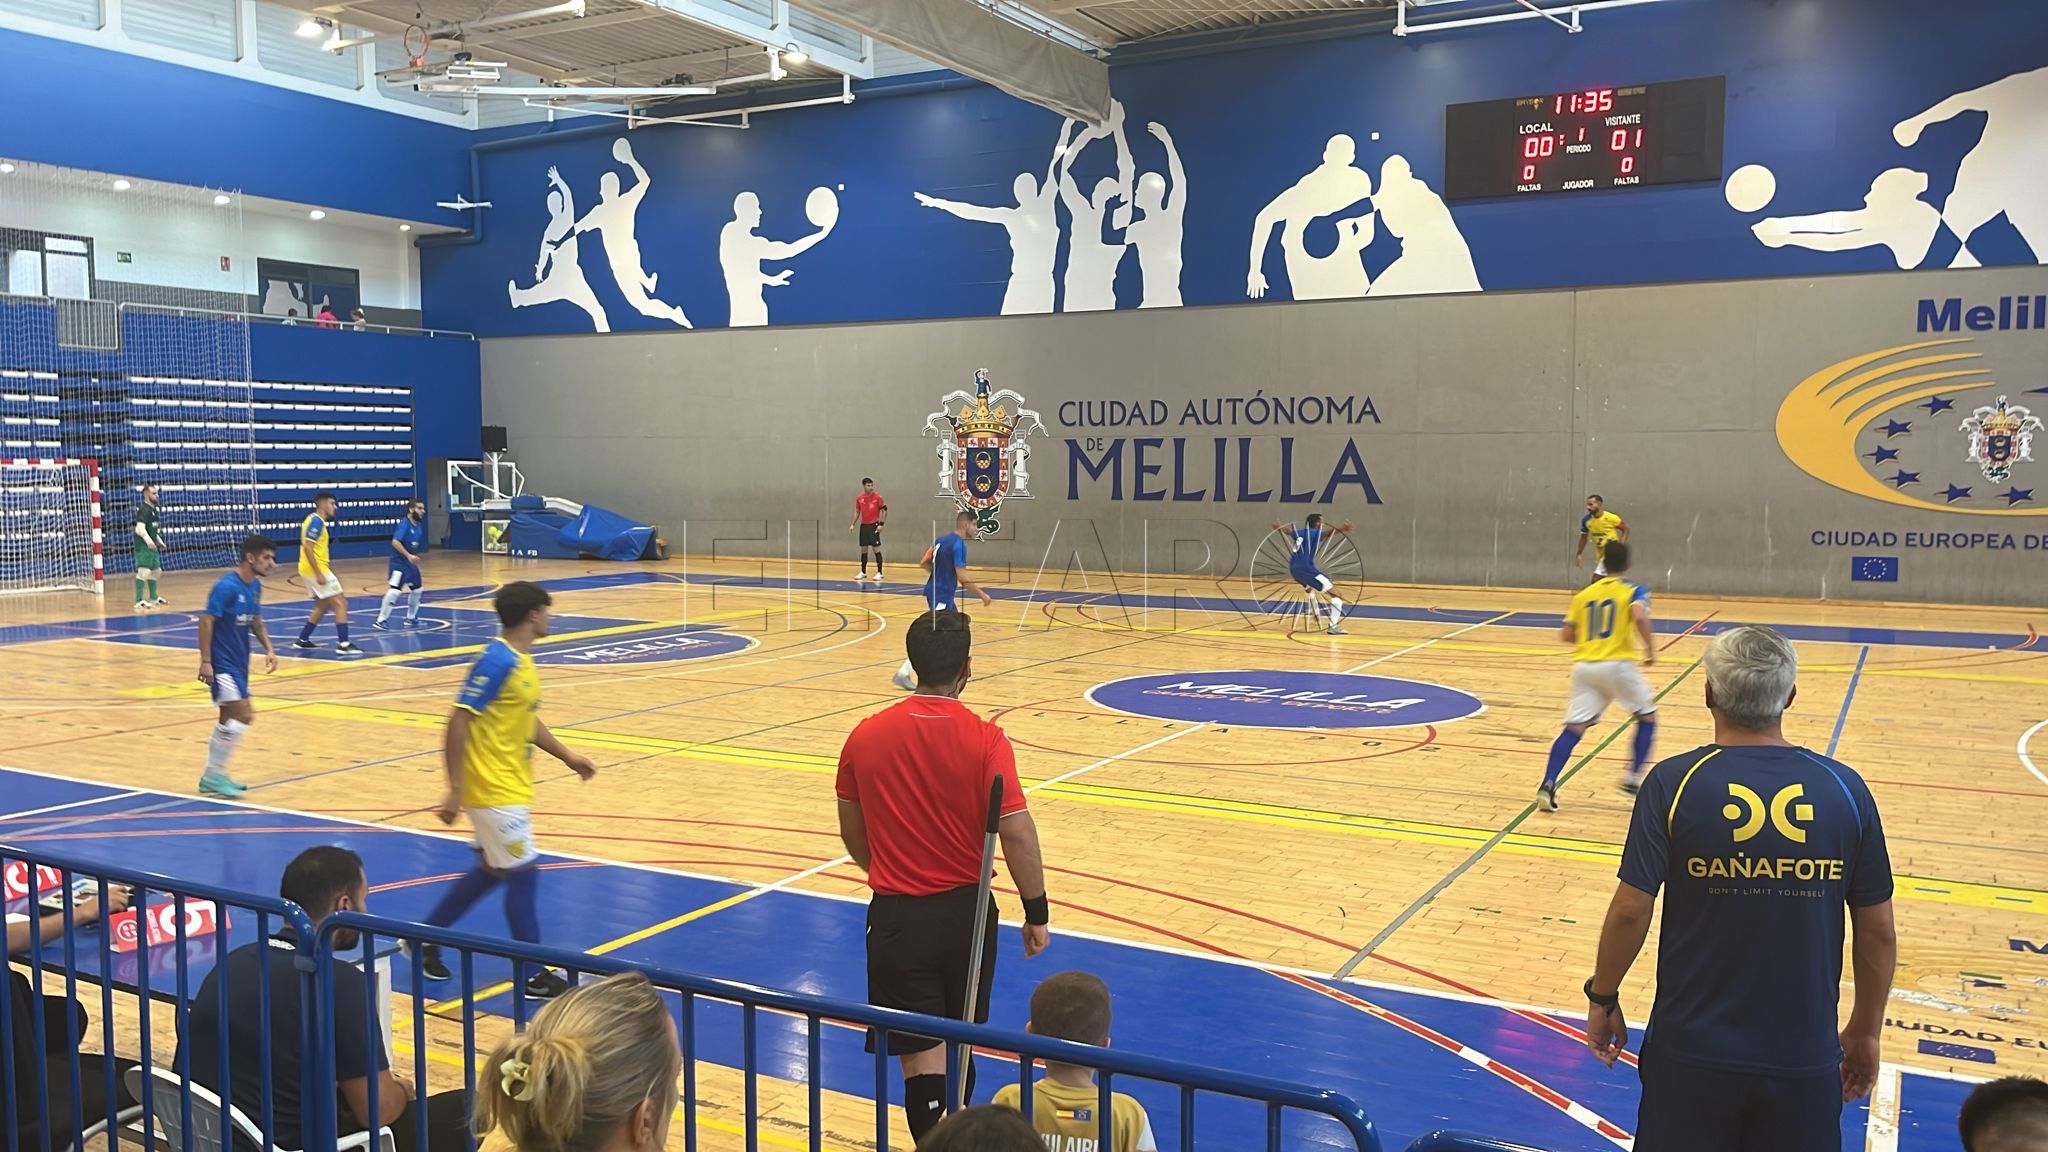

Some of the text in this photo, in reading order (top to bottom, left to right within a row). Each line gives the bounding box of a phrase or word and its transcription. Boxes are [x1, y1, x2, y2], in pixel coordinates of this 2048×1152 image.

[1555, 90, 1613, 114] 11:35
[1519, 122, 1554, 135] LOCAL
[1605, 114, 1641, 127] VISITANTE
[1578, 127, 1586, 142] 1
[1611, 129, 1644, 151] 01
[1524, 136, 1554, 158] 00
[1566, 144, 1592, 154] PERIODO
[1523, 165, 1535, 180] 0
[1621, 157, 1634, 173] 0
[1517, 184, 1541, 192] FALTAS
[1562, 180, 1594, 190] JUGADOR
[1613, 176, 1640, 185] FALTAS
[1058, 400, 1168, 427] CIUDAD
[1179, 390, 1382, 425] AUTÓNOMA
[1063, 436, 1384, 505] DE MELILLA
[1811, 530, 1898, 547] CIUDAD
[1905, 531, 2016, 549] EUROPEA
[1584, 598, 1617, 642] 10
[1157, 681, 1426, 709] MELILLA
[1884, 1018, 2005, 1042] IUDAD
